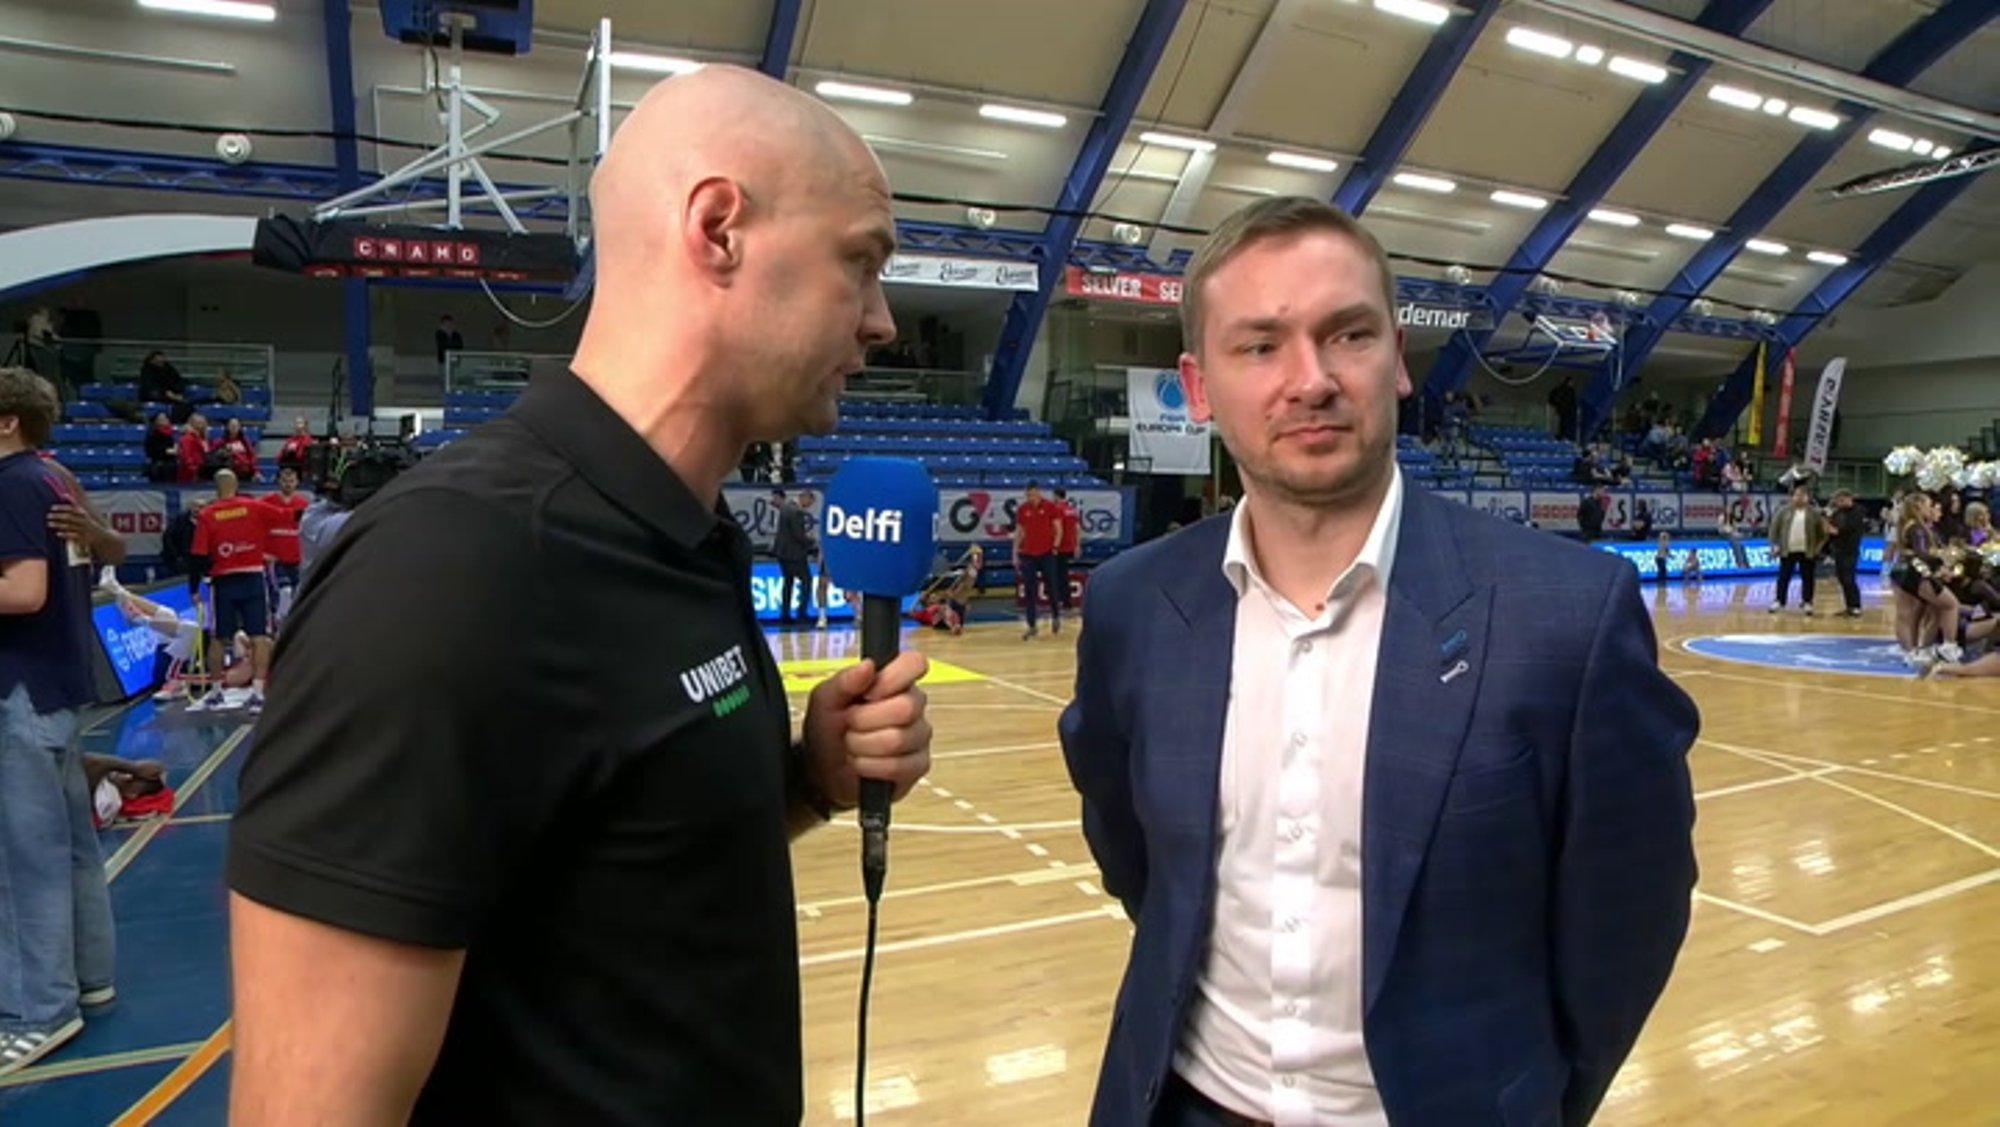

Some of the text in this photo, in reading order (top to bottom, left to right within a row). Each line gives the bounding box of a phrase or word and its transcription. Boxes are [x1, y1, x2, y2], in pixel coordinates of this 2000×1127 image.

[1082, 274, 1141, 297] SELVER
[1399, 302, 1470, 327] demar
[826, 505, 902, 543] Delfi
[680, 645, 747, 702] UNIBET
